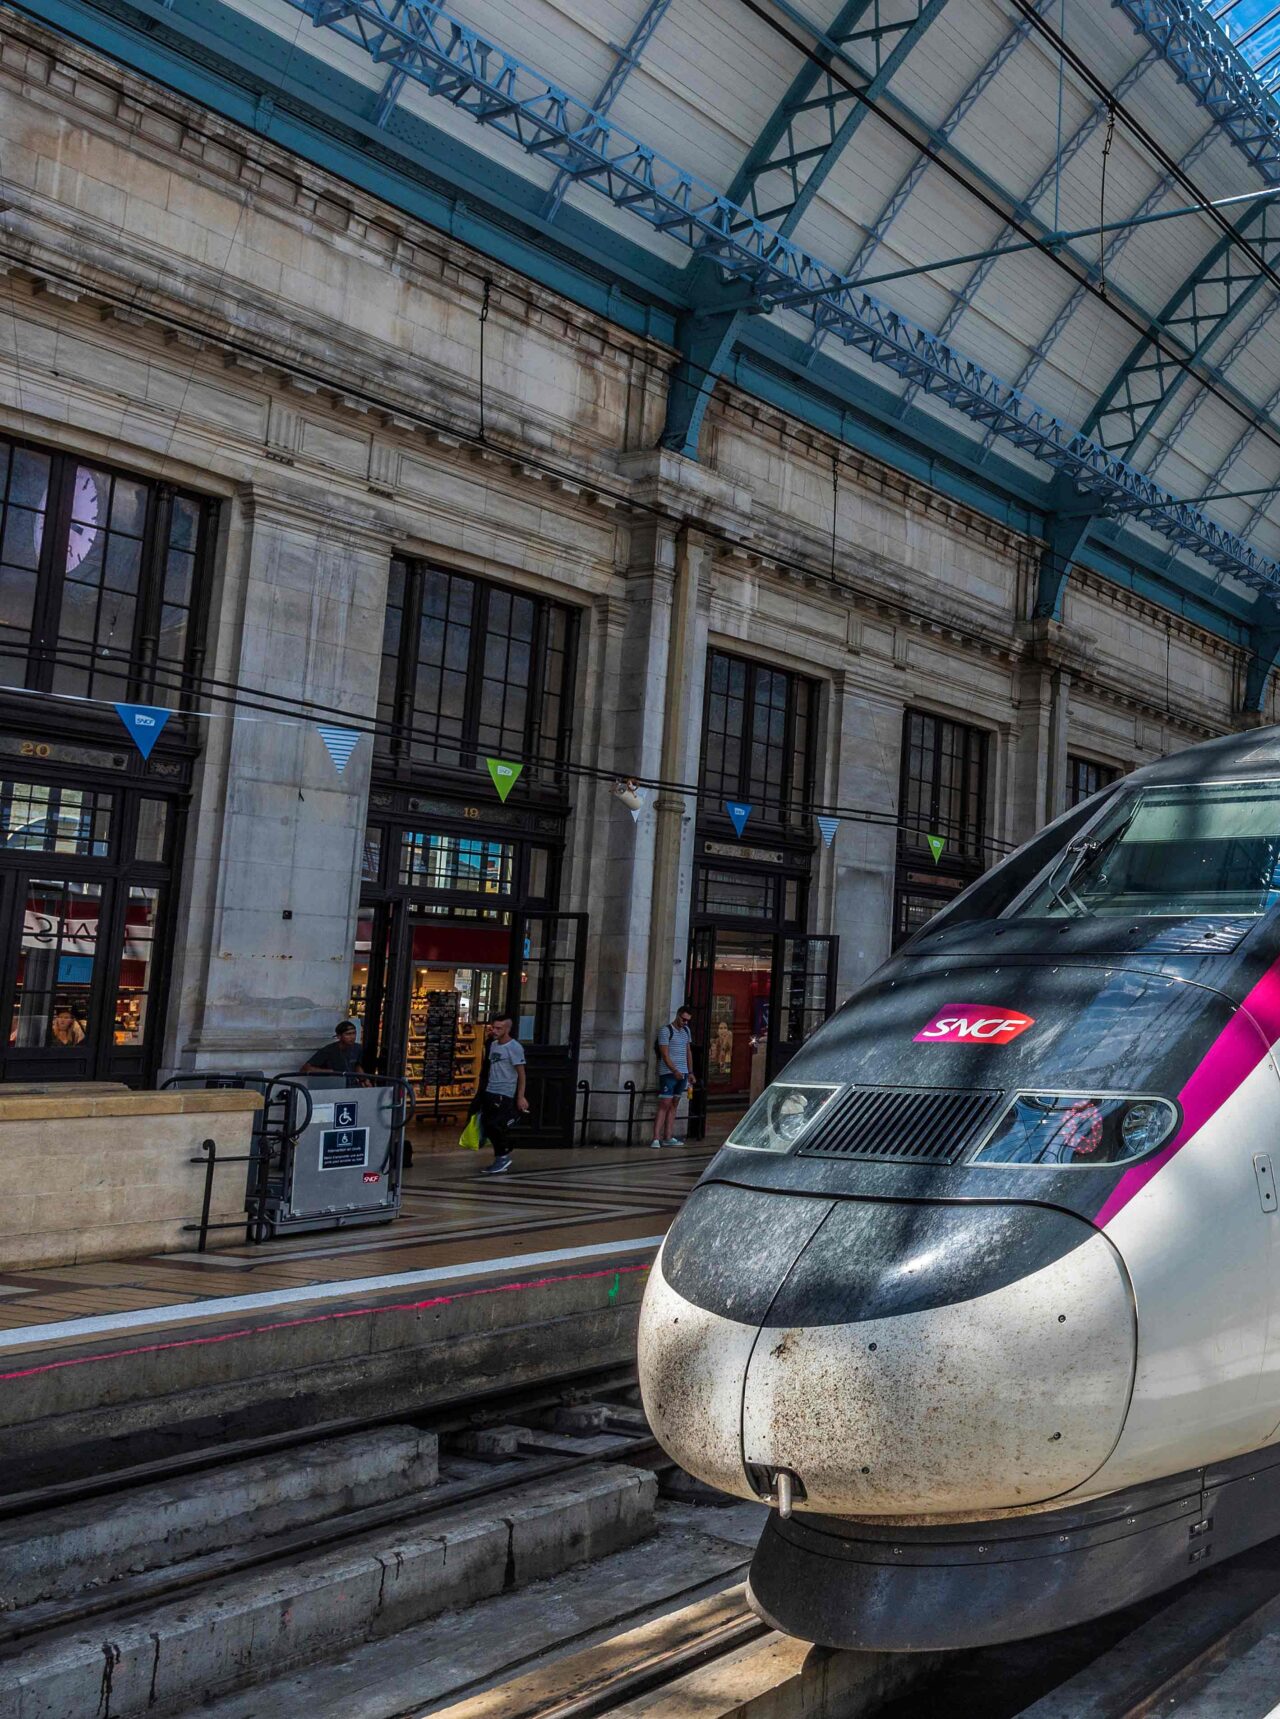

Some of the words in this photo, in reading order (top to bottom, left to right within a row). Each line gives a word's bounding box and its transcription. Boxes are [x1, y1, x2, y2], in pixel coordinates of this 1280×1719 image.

[136, 716, 155, 726] SNCF
[20, 742, 50, 757] 20
[463, 807, 479, 819] 19
[922, 1018, 1027, 1038] SNCF
[363, 1175, 379, 1183] SNCF
